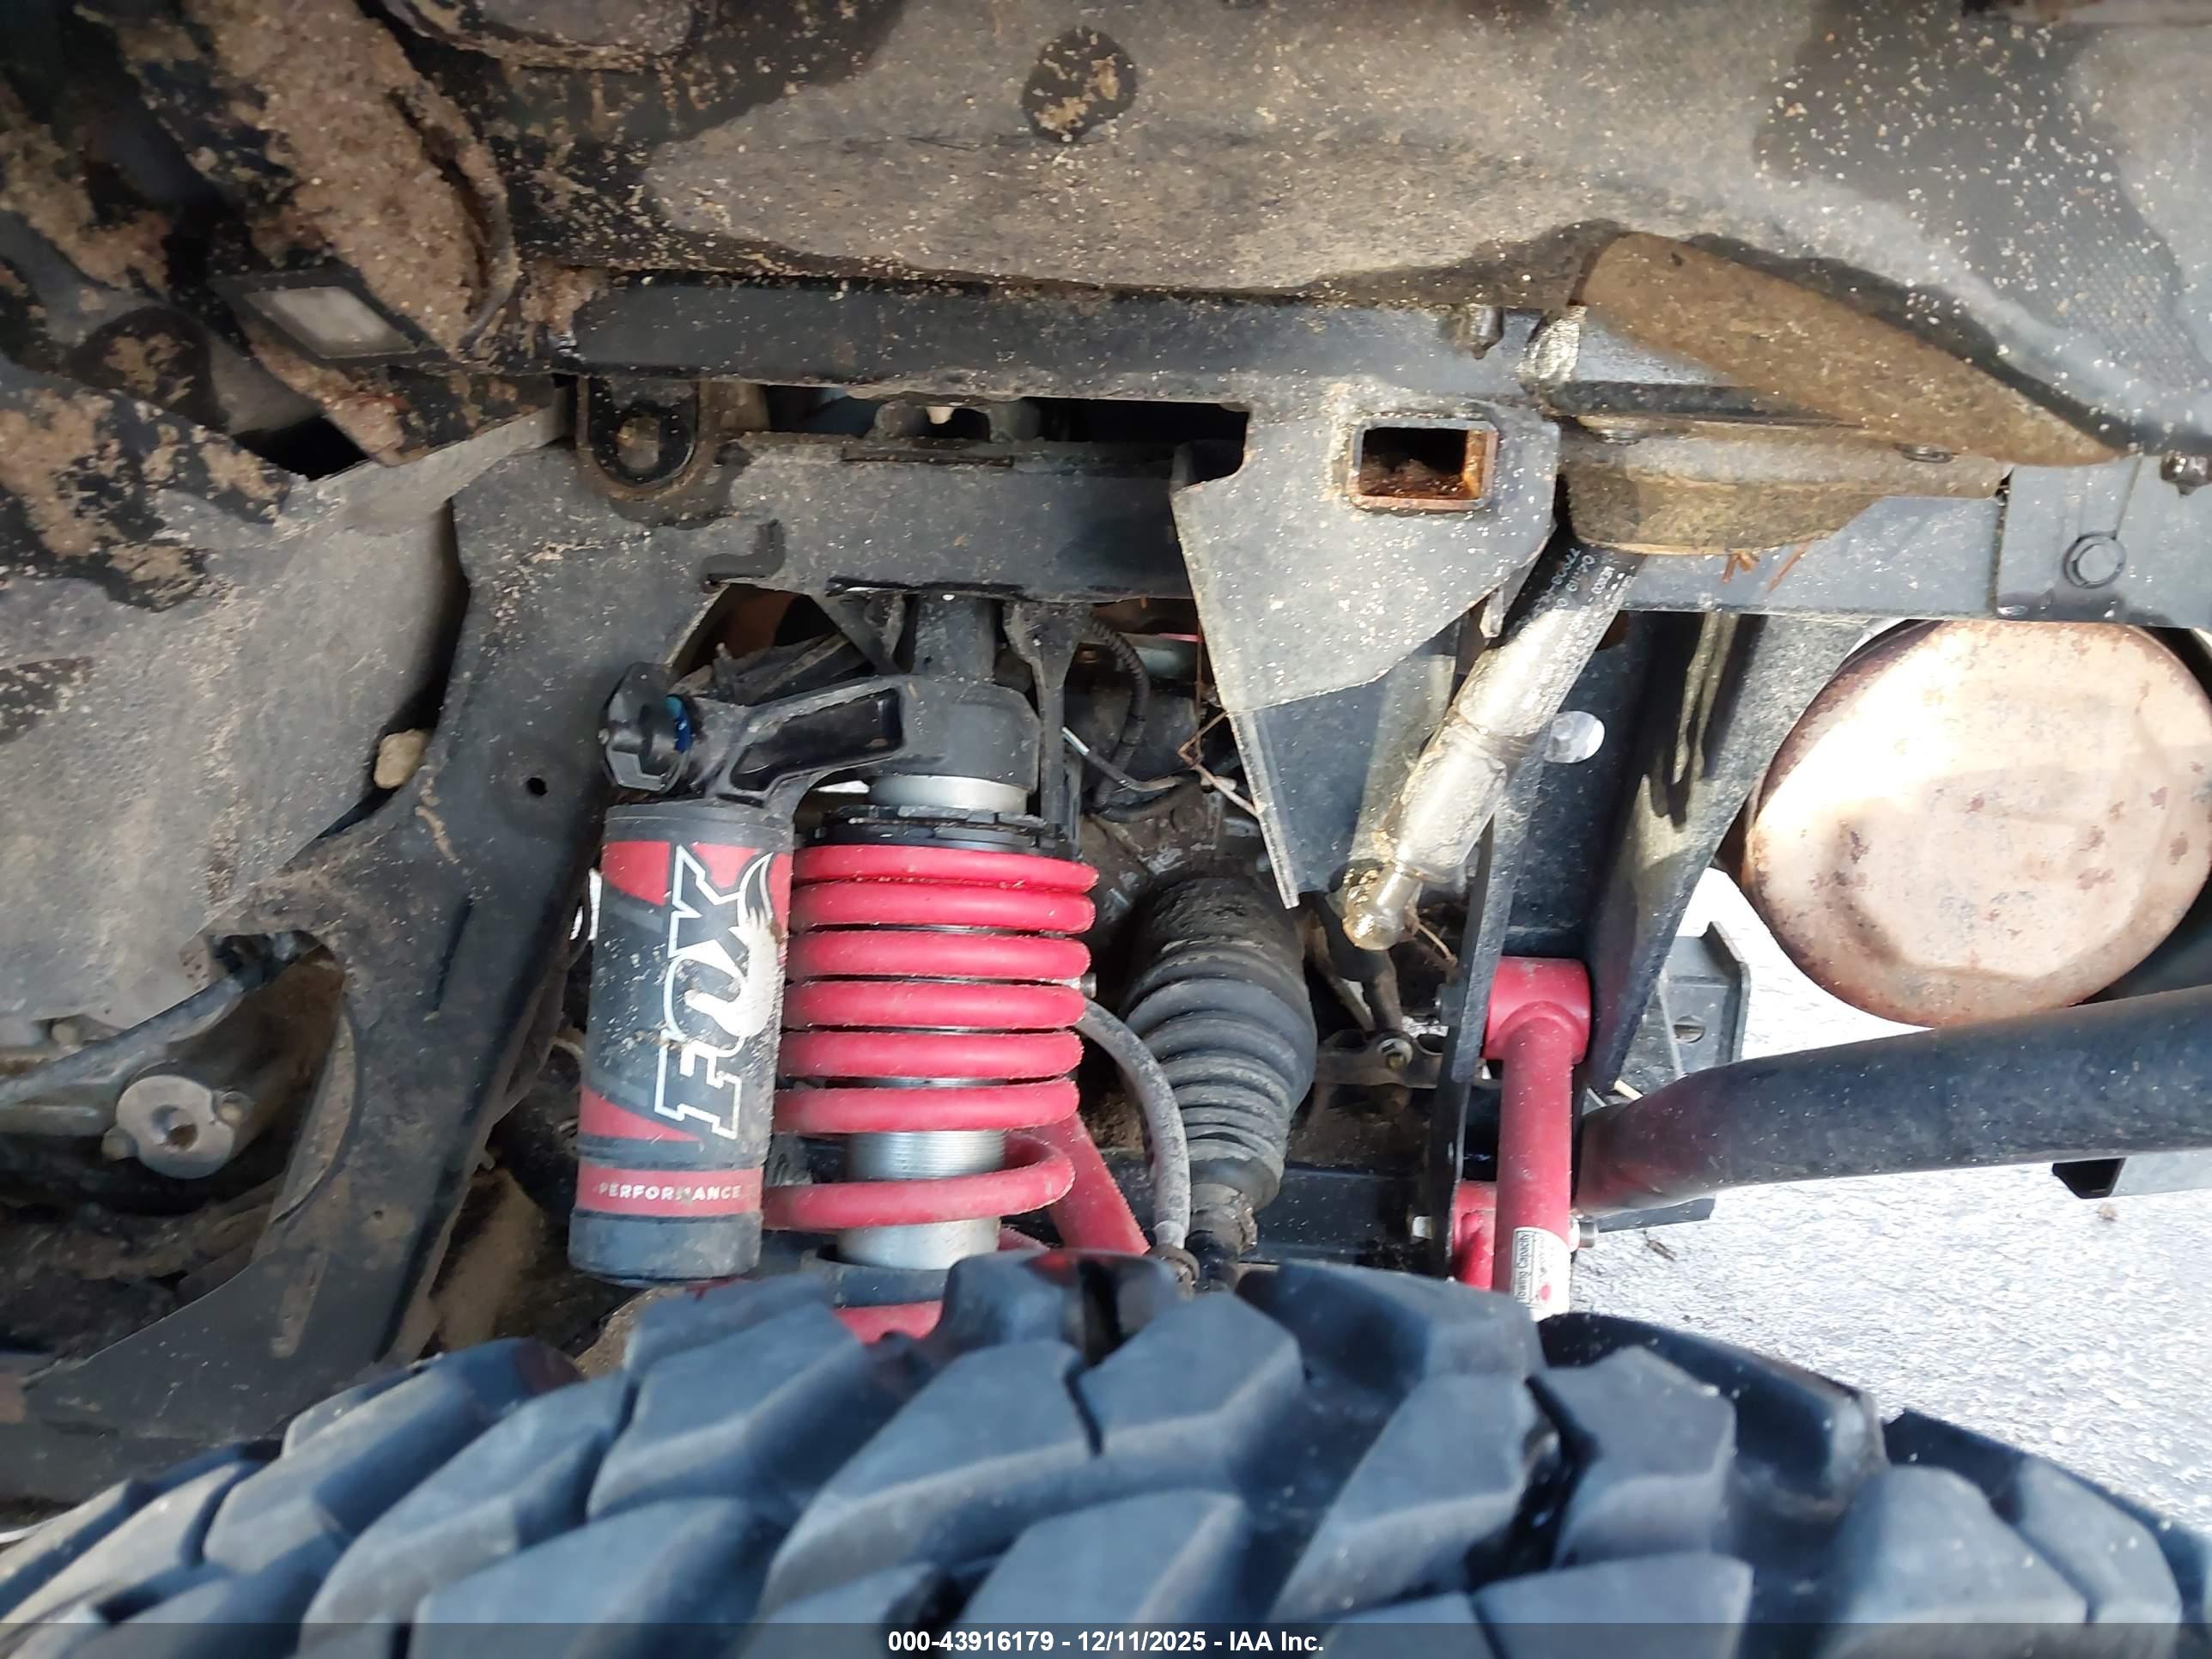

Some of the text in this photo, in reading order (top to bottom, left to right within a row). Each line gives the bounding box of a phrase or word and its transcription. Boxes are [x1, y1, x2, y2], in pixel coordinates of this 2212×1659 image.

[654, 844, 778, 1139] FOX
[1516, 1231, 1533, 1302] Towing Capacity
